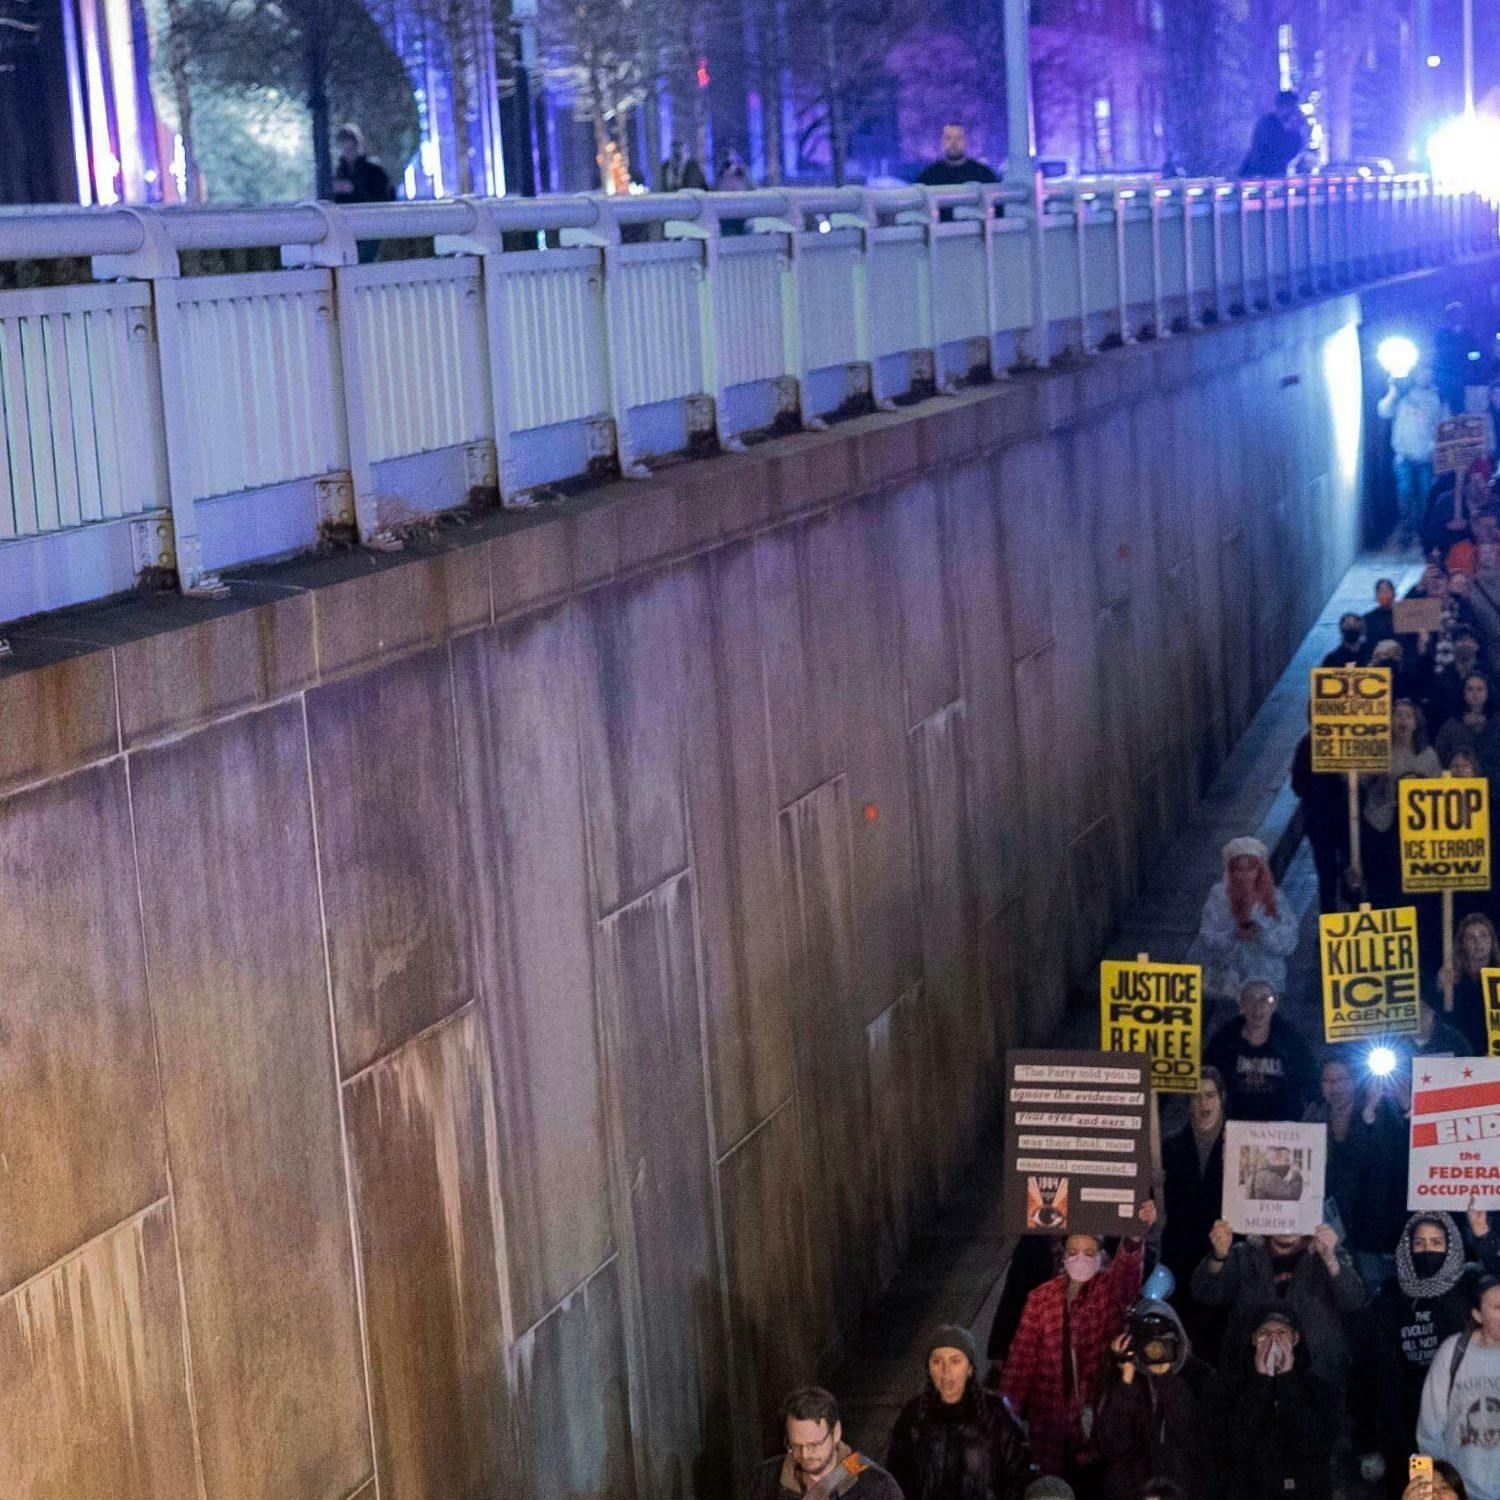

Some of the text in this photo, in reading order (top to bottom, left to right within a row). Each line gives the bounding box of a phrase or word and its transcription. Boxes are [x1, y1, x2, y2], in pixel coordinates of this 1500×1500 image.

[1315, 672, 1387, 700] DC
[1315, 723, 1388, 736] STOP
[1407, 788, 1482, 831] STOP
[1404, 838, 1485, 860] ICE TERROR
[1409, 861, 1481, 875] NOW
[1326, 909, 1412, 939] JAIL
[1328, 936, 1414, 974] KILLER
[1110, 969, 1197, 1004] JUSTICE
[1331, 977, 1415, 1009] ICE
[1110, 1004, 1192, 1025] FOR
[1332, 1003, 1417, 1022] AGENTS
[1110, 1029, 1191, 1059] RENEE
[1248, 1129, 1300, 1142] WANTED
[1459, 1151, 1482, 1161] the
[1258, 1203, 1283, 1215] FOR
[1244, 1217, 1297, 1229] MURDER
[1415, 1310, 1432, 1322] THE
